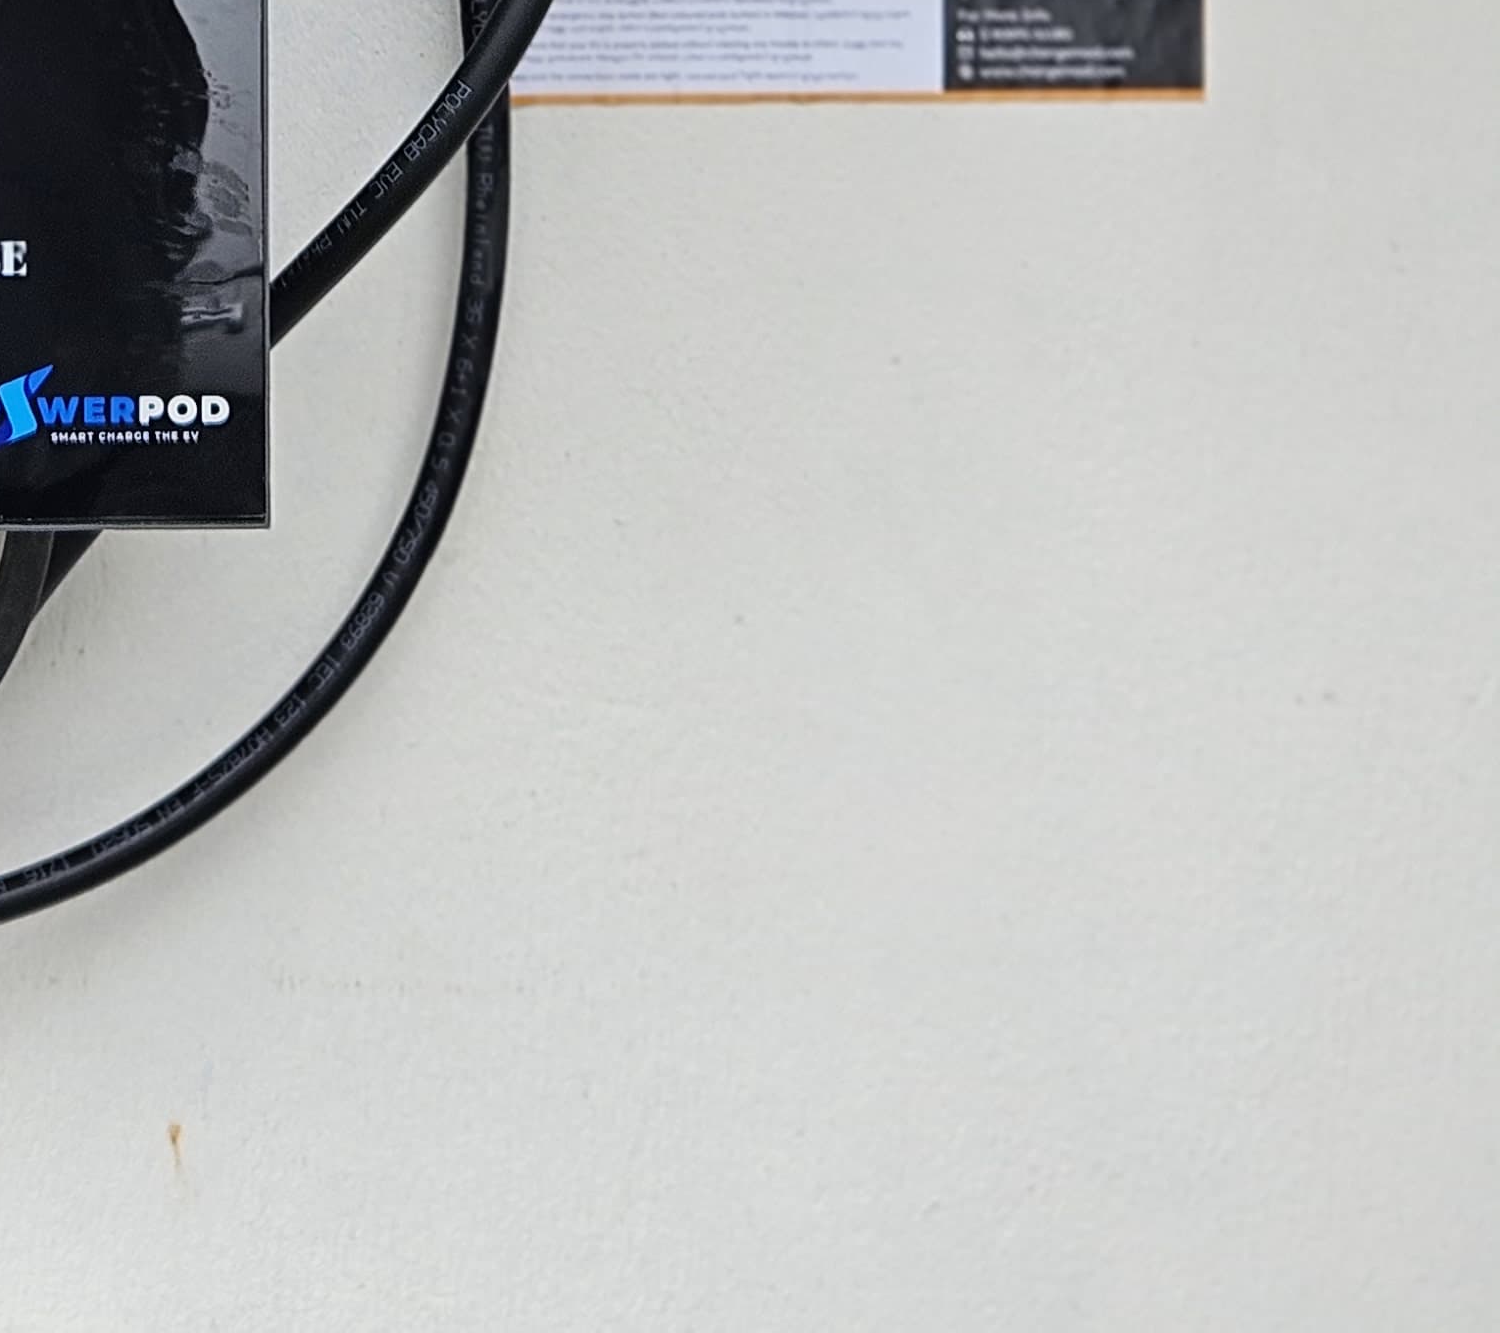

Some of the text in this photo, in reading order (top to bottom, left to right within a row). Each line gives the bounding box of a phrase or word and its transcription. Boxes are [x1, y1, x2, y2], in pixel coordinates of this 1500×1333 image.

[403, 79, 475, 162] POLYCAB
[373, 160, 405, 200] EVC
[51, 431, 94, 445] SMART
[98, 430, 150, 444] CHARGE
[154, 430, 179, 443] THE
[338, 593, 387, 652] 62893
